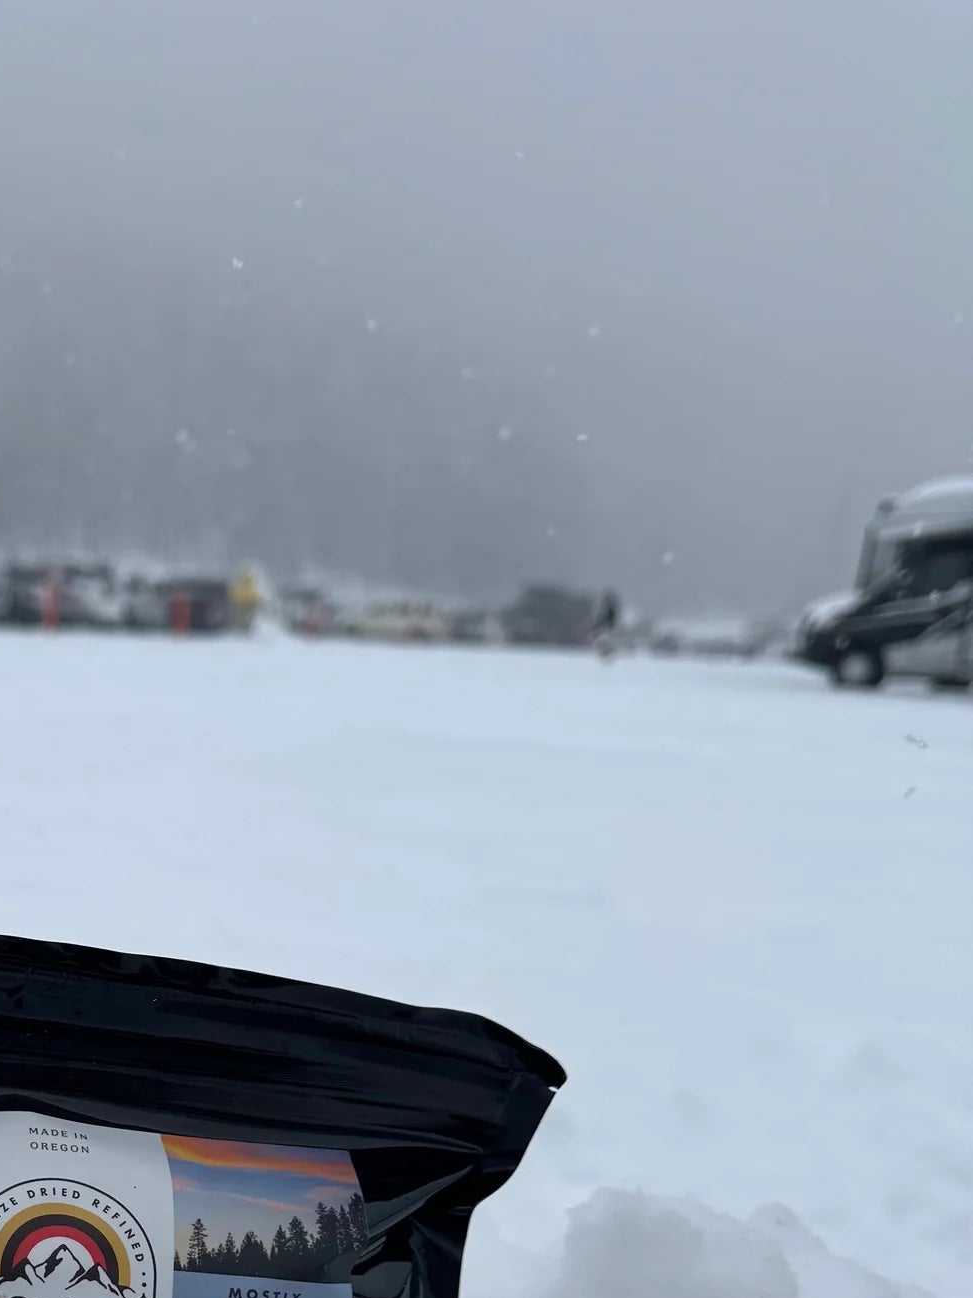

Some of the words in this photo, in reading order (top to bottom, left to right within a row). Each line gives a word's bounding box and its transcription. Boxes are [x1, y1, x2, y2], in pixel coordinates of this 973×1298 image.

[29, 1127, 69, 1138] MADE
[74, 1132, 88, 1141] IN
[30, 1141, 90, 1154] OREGON
[27, 1187, 81, 1200] DRIED
[91, 1198, 145, 1262] REFINED
